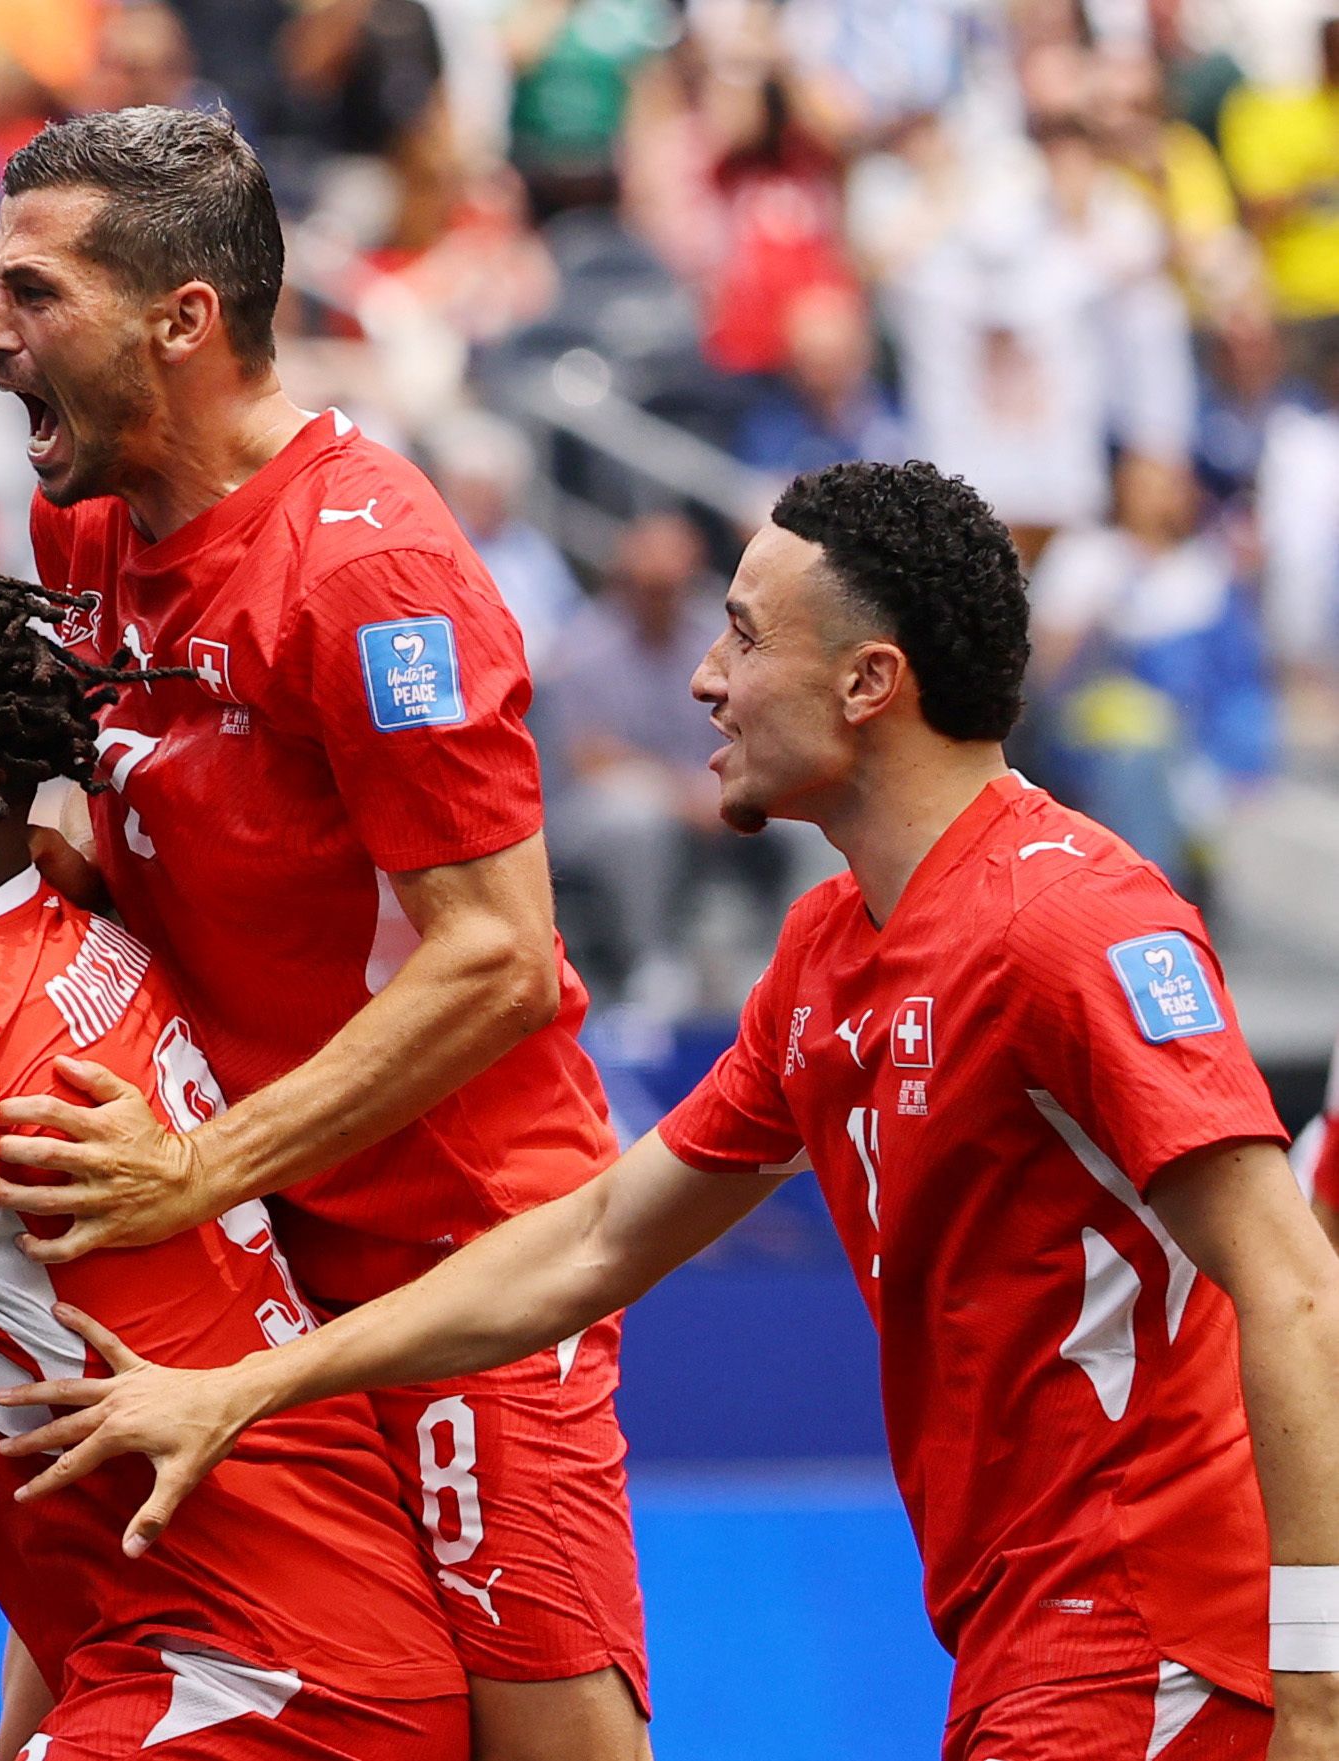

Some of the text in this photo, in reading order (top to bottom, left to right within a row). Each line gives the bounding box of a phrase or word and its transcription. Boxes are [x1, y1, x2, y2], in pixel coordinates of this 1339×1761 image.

[388, 664, 437, 688] Unite For
[393, 684, 437, 706] PEACE
[405, 704, 431, 716] FIFA
[1159, 993, 1199, 1015] PEACE
[416, 1394, 484, 1566] 8
